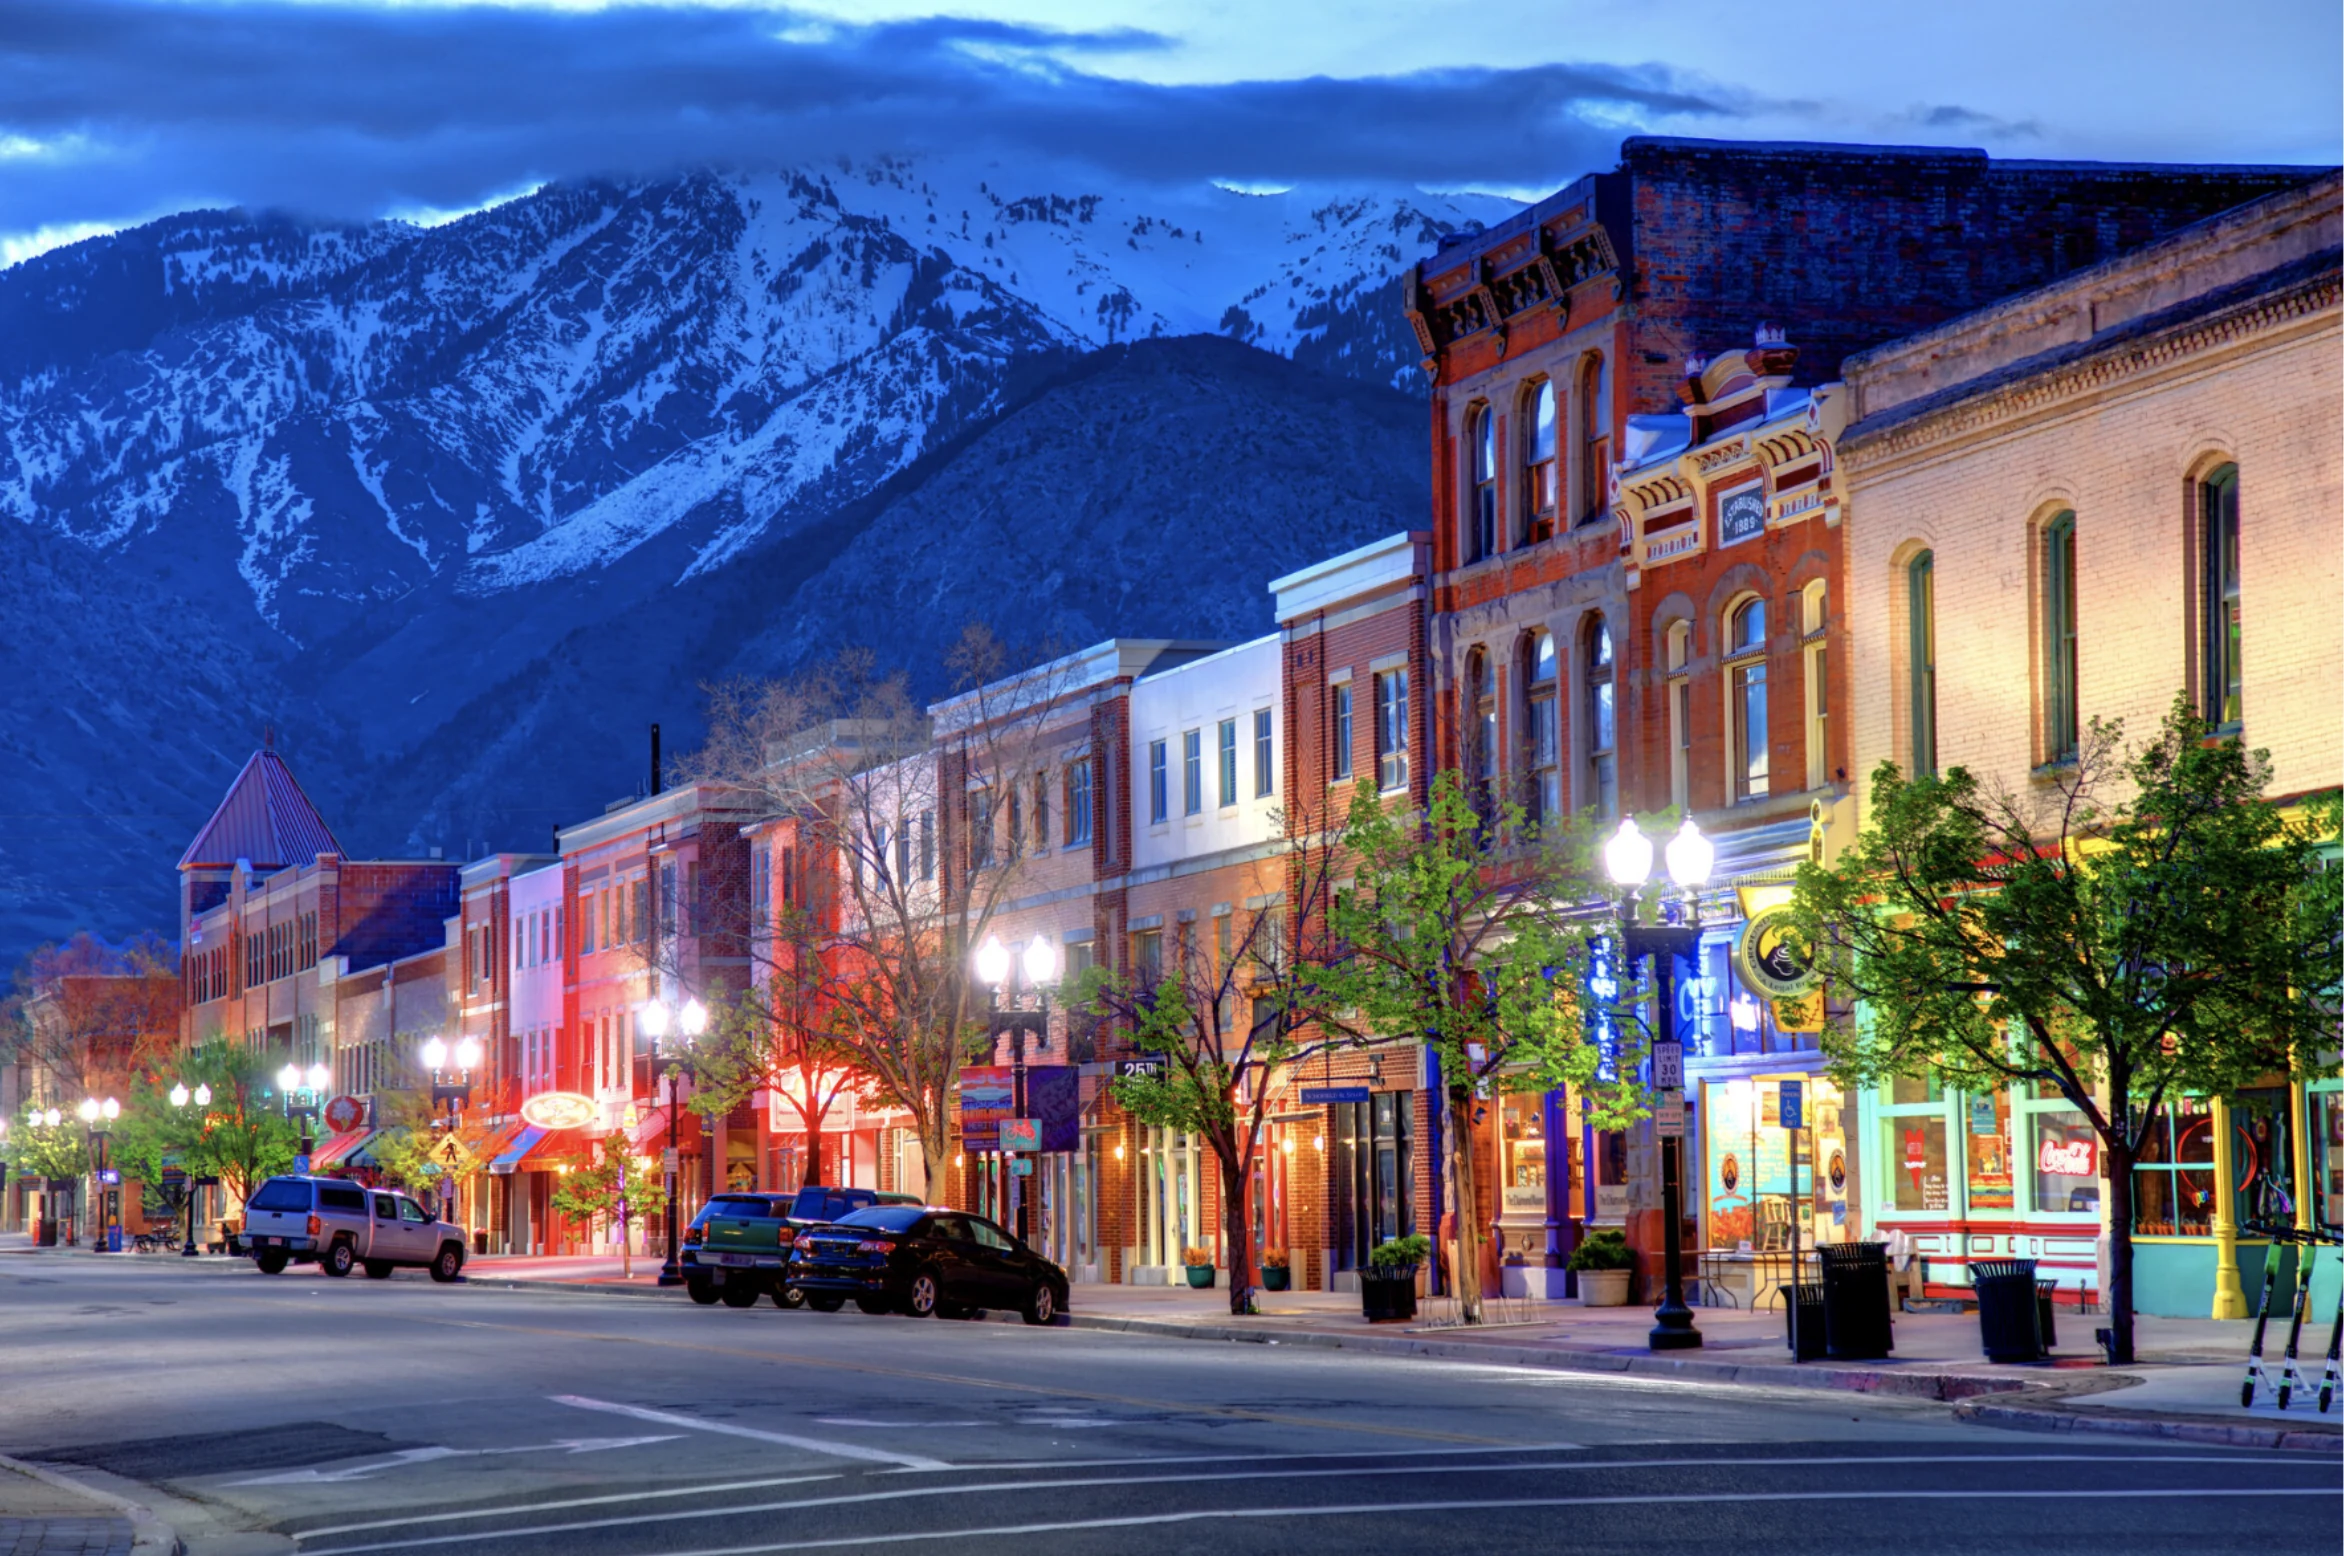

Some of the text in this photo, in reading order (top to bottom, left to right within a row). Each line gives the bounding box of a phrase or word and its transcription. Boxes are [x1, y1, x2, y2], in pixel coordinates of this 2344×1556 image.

[1725, 495, 1764, 529] ESTABLISHED
[1734, 515, 1756, 536] 1889
[1656, 1045, 1680, 1055] SPEED
[1659, 1055, 1679, 1063] LIMIT
[1124, 1062, 1157, 1078] 25TH
[1661, 1063, 1677, 1076] 30
[1660, 1077, 1678, 1085] MPH
[967, 1120, 999, 1131] HERITA
